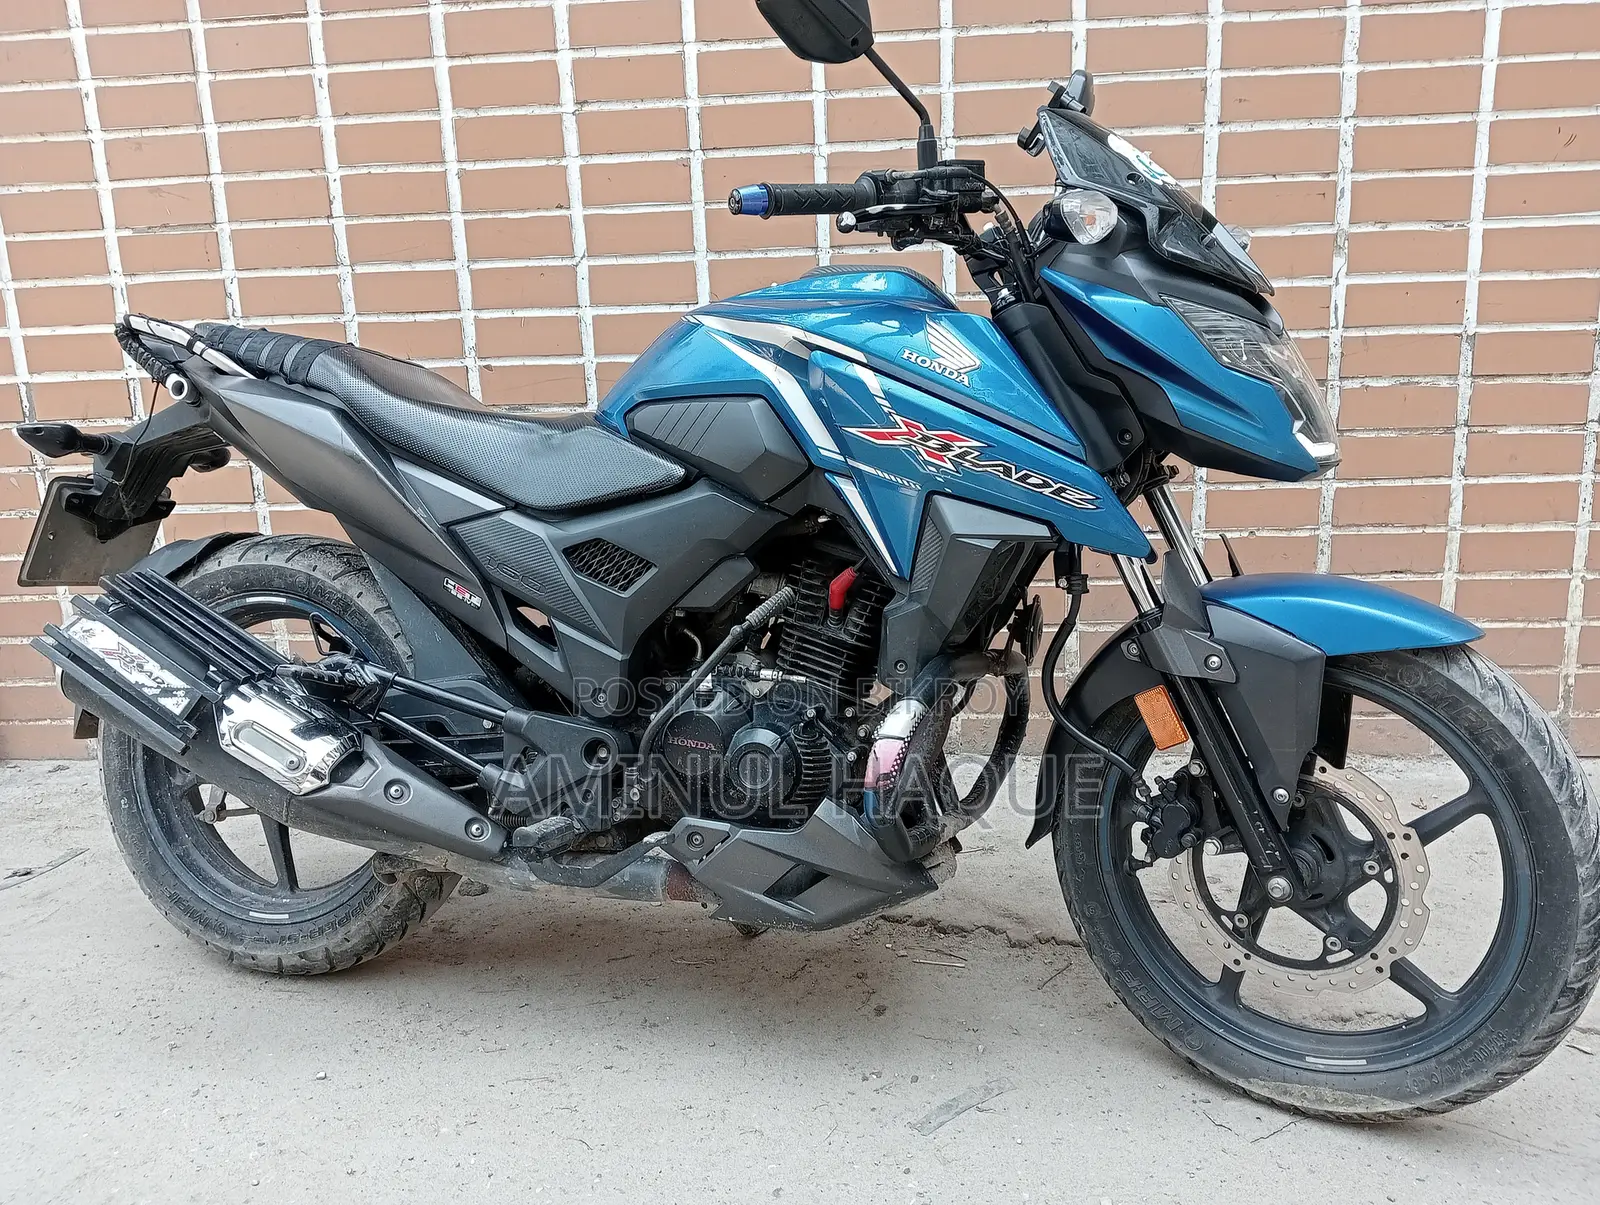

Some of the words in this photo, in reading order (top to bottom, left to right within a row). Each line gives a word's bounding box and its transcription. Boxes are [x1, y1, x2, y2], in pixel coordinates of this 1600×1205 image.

[901, 348, 972, 387] HONDA
[668, 736, 718, 751] HONDA
[1116, 968, 1185, 1032] MRF
